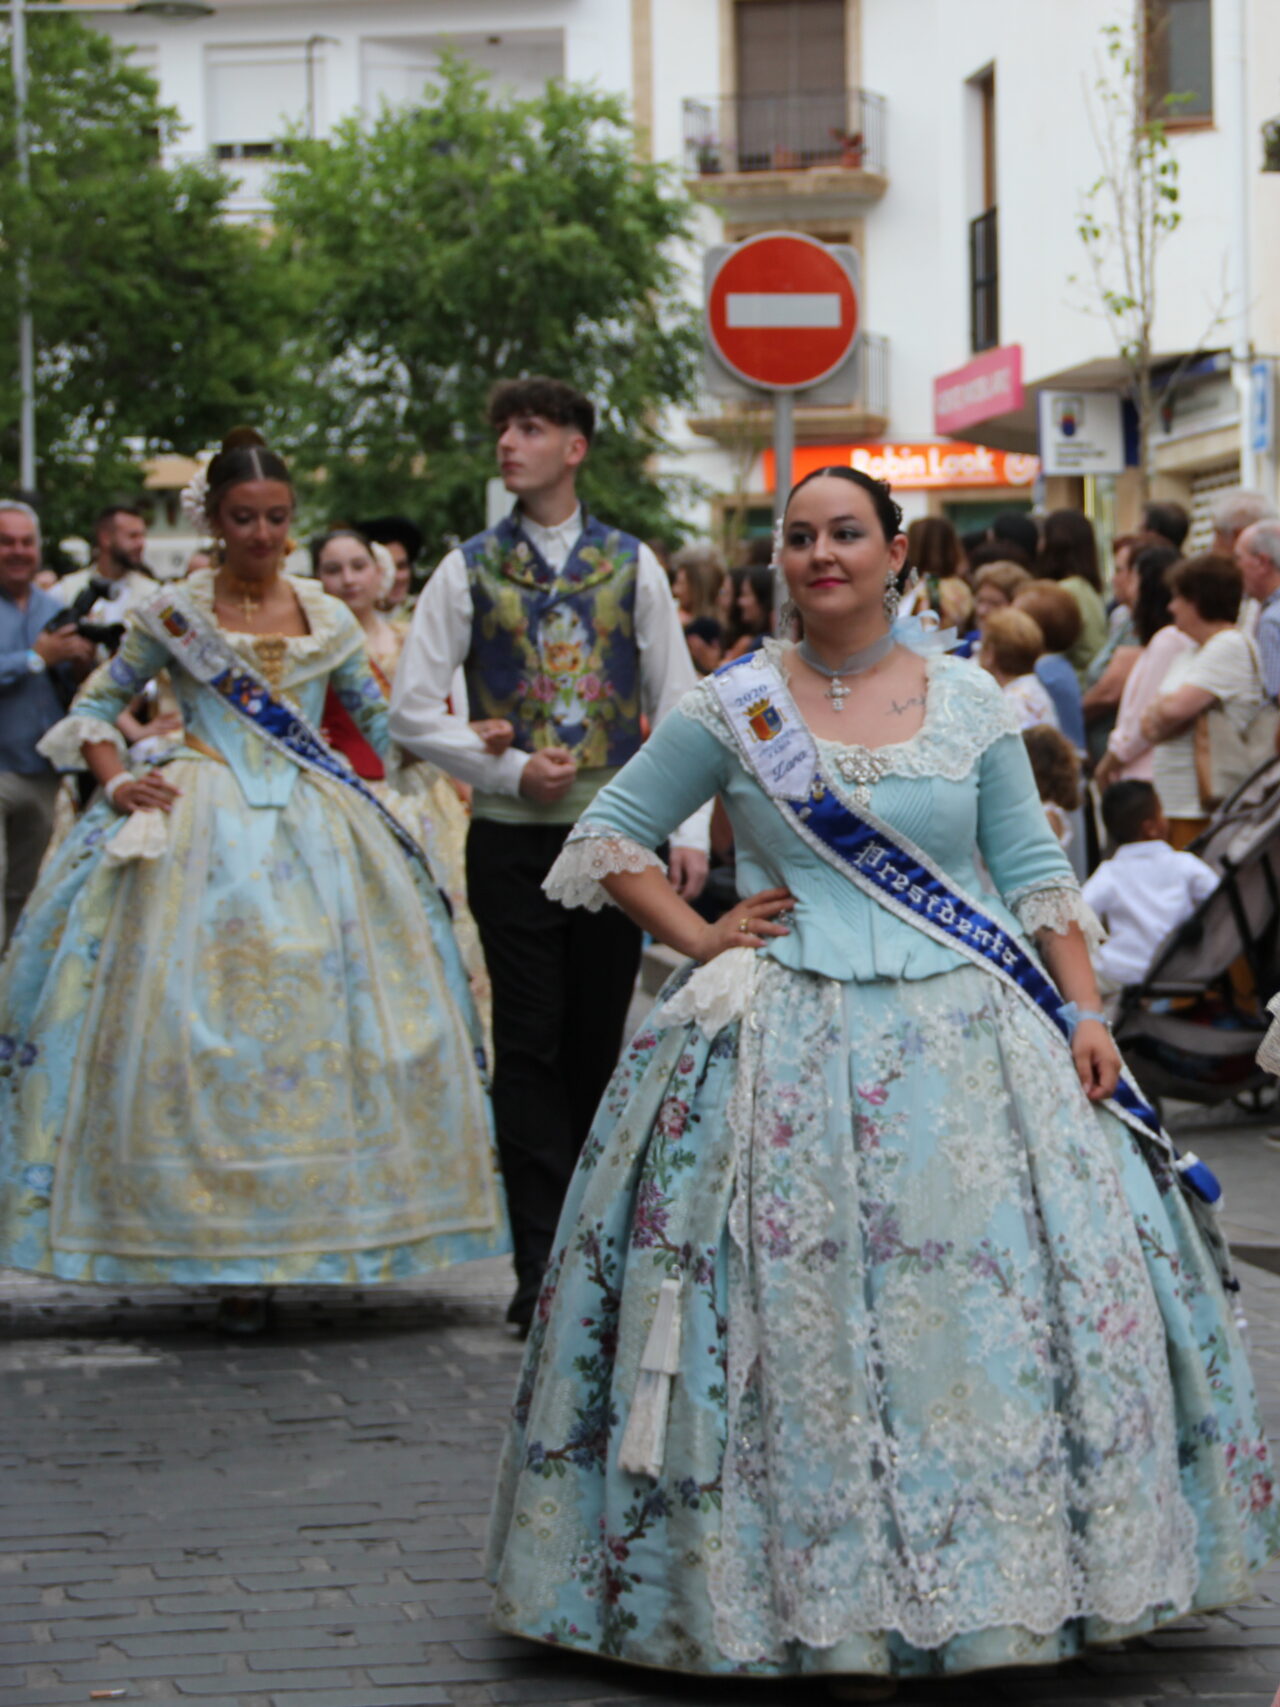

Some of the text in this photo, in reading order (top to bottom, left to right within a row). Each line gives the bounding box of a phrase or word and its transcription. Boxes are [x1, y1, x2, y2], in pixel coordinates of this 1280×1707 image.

[851, 445, 995, 480] Robin Look
[735, 684, 768, 708] 2020
[853, 840, 1019, 966] Presidenta
